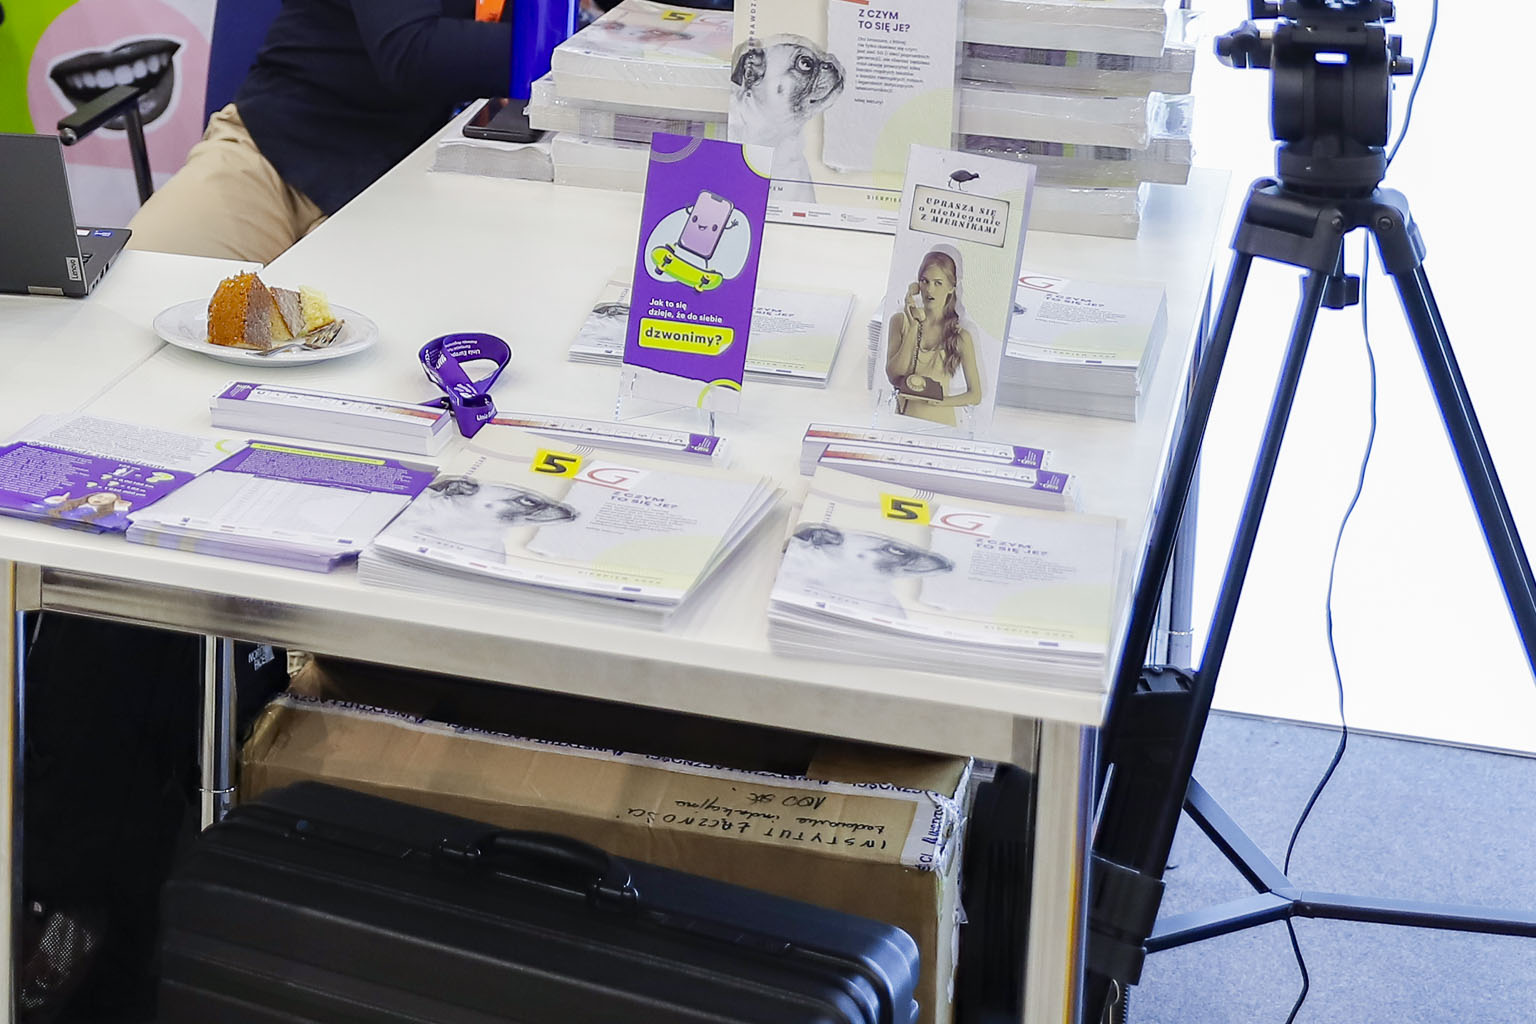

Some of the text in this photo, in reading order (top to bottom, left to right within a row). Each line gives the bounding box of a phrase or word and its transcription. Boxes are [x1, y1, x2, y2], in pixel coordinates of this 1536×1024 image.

[858, 9, 899, 20] Z CZYM
[858, 20, 911, 33] TO SIĘ JE?
[926, 197, 997, 219] UPRASZA SIĘ
[930, 207, 1001, 227] niebieganie
[931, 215, 997, 235] MIERNIKAMI
[70, 258, 78, 279] Lenovo
[649, 298, 687, 311] Jak to się
[648, 308, 723, 324] dzieje, że do siebie
[645, 326, 722, 347] dzwonimy?
[763, 828, 886, 849] INSTYTUT
